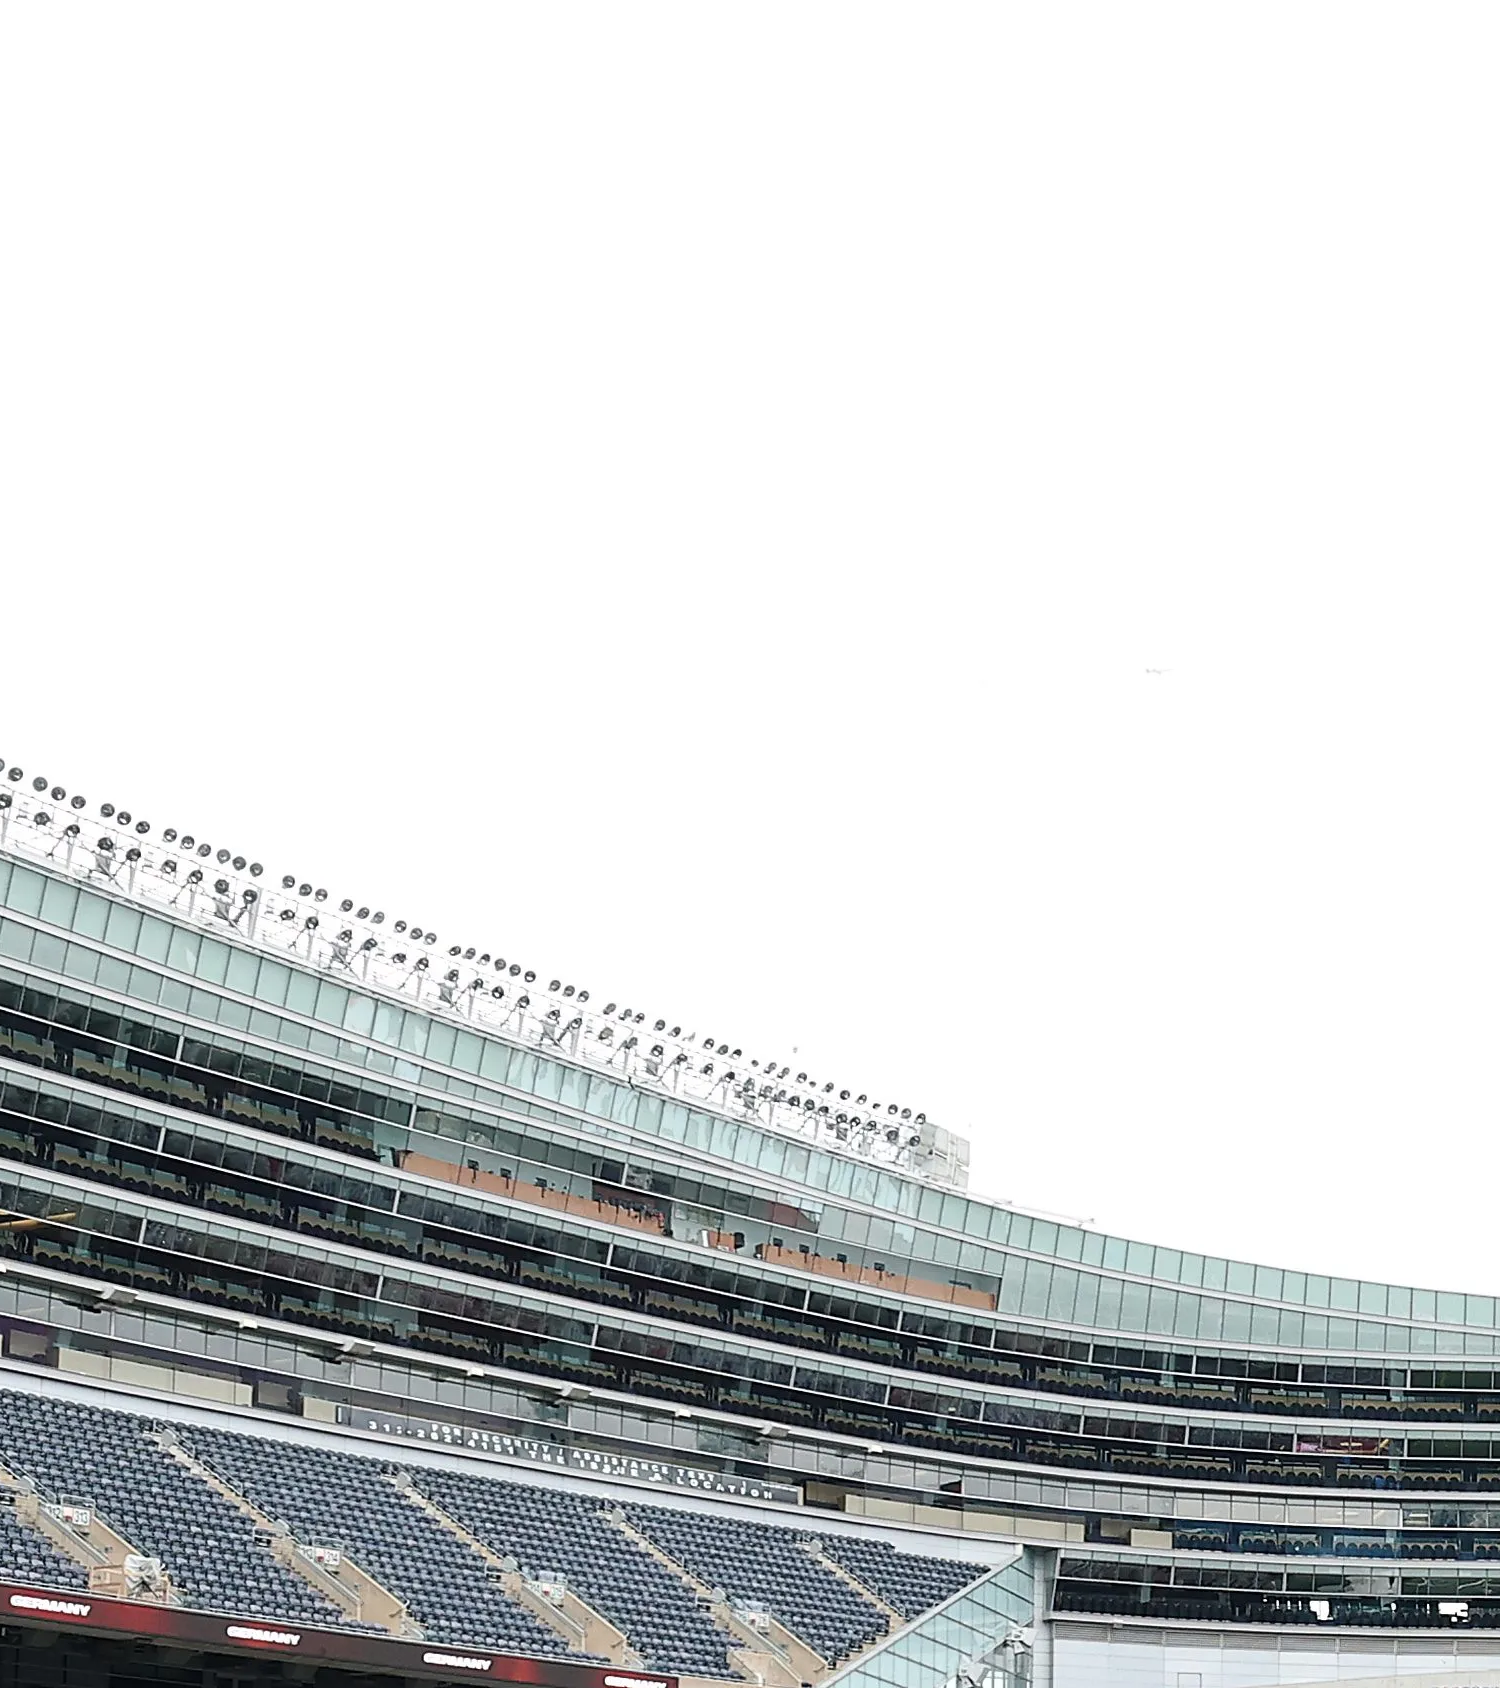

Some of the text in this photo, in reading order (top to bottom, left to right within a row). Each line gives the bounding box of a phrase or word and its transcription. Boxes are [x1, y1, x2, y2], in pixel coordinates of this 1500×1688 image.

[472, 1431, 550, 1452] SECURITY
[573, 1450, 669, 1475] ASSISTANCE
[9, 1595, 91, 1618] GERMANY
[226, 1626, 301, 1647] GERMANY
[423, 1652, 492, 1672] GERMANY
